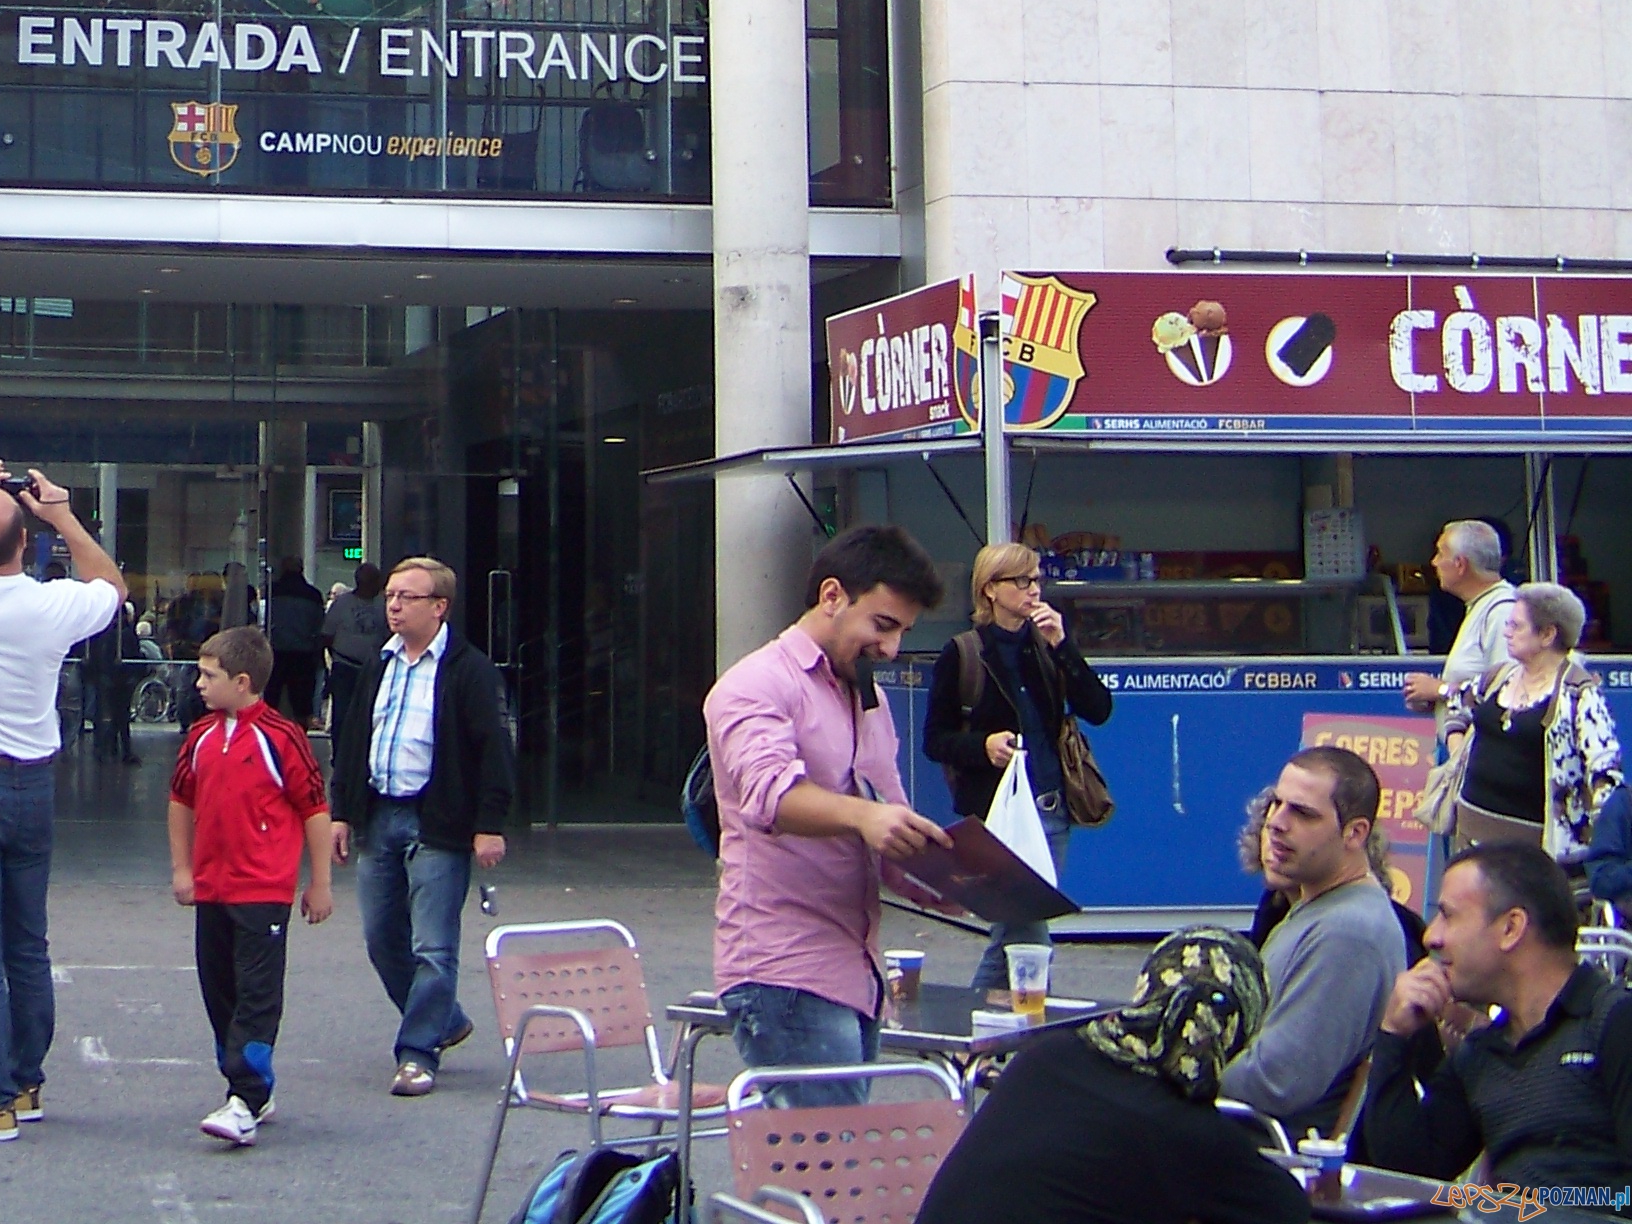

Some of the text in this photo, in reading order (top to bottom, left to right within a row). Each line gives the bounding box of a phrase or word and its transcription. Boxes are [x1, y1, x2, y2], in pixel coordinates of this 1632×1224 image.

[17, 16, 323, 73] ENTRADA
[380, 28, 707, 84] ENTRANCE
[386, 130, 503, 161] experience
[1104, 417, 1266, 430] SERHS ALIMENTACIÓ FCBBAR
[1123, 671, 1226, 690] ALIMENTACIÓ
[1243, 672, 1317, 690] FCBBAR
[1359, 671, 1405, 689] SERH
